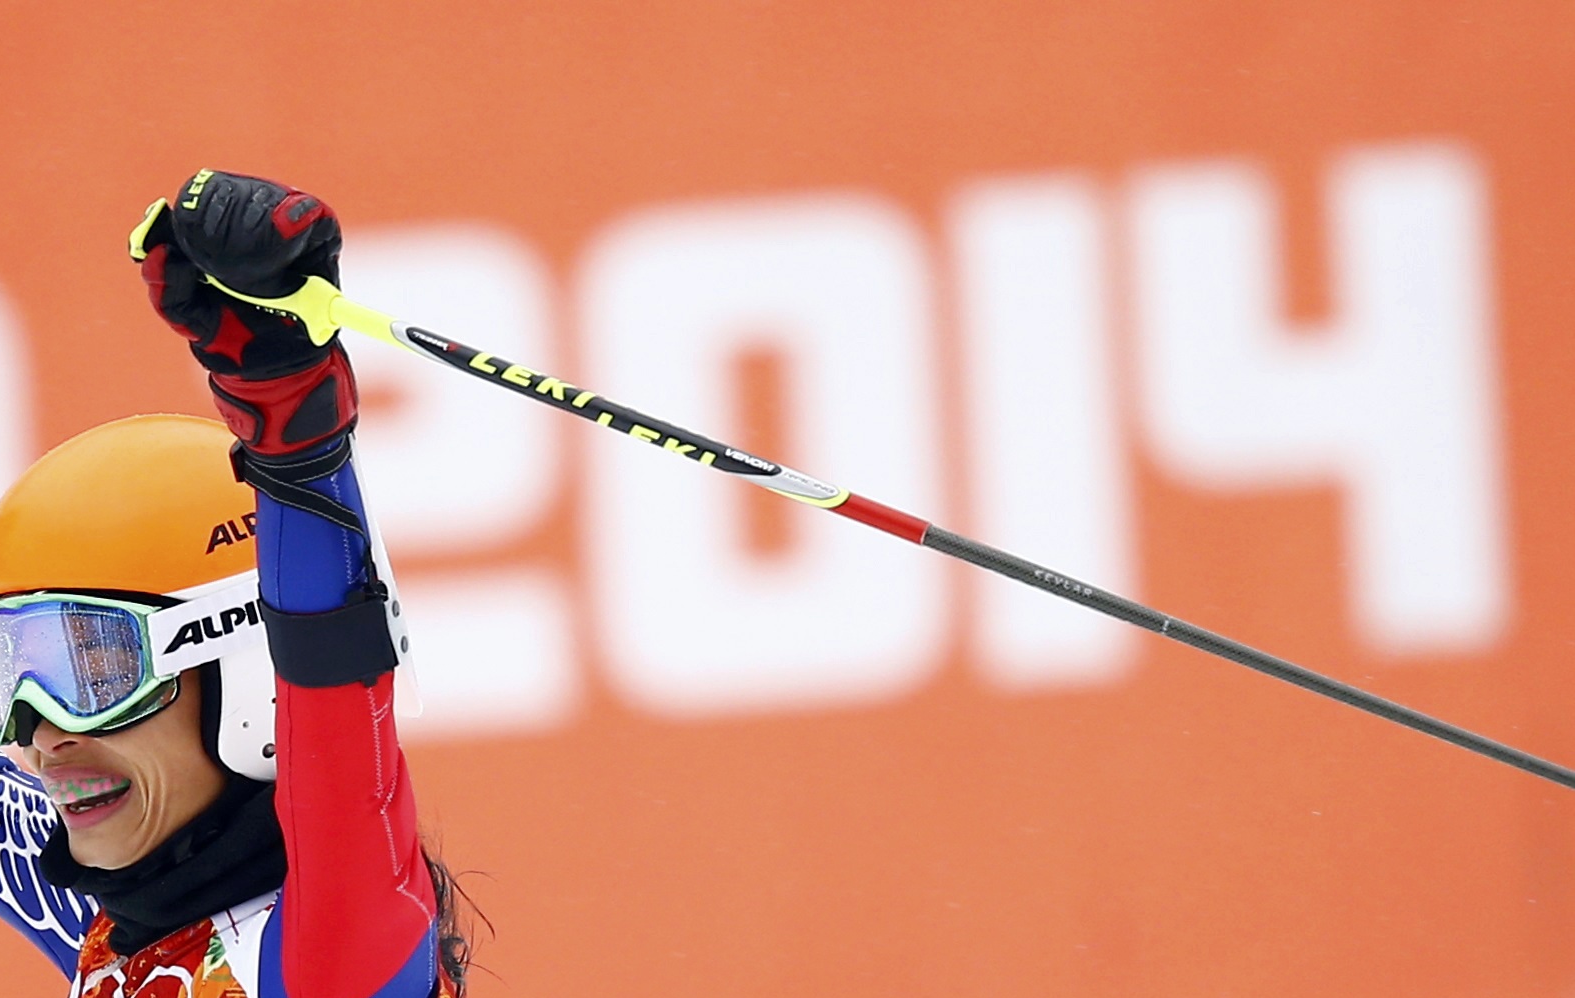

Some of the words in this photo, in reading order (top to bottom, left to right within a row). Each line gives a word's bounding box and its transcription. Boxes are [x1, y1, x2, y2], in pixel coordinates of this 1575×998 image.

[468, 350, 597, 408] LEKI
[337, 142, 1512, 740] 2014
[725, 448, 775, 472] VENOM
[161, 599, 266, 656] ALPI
